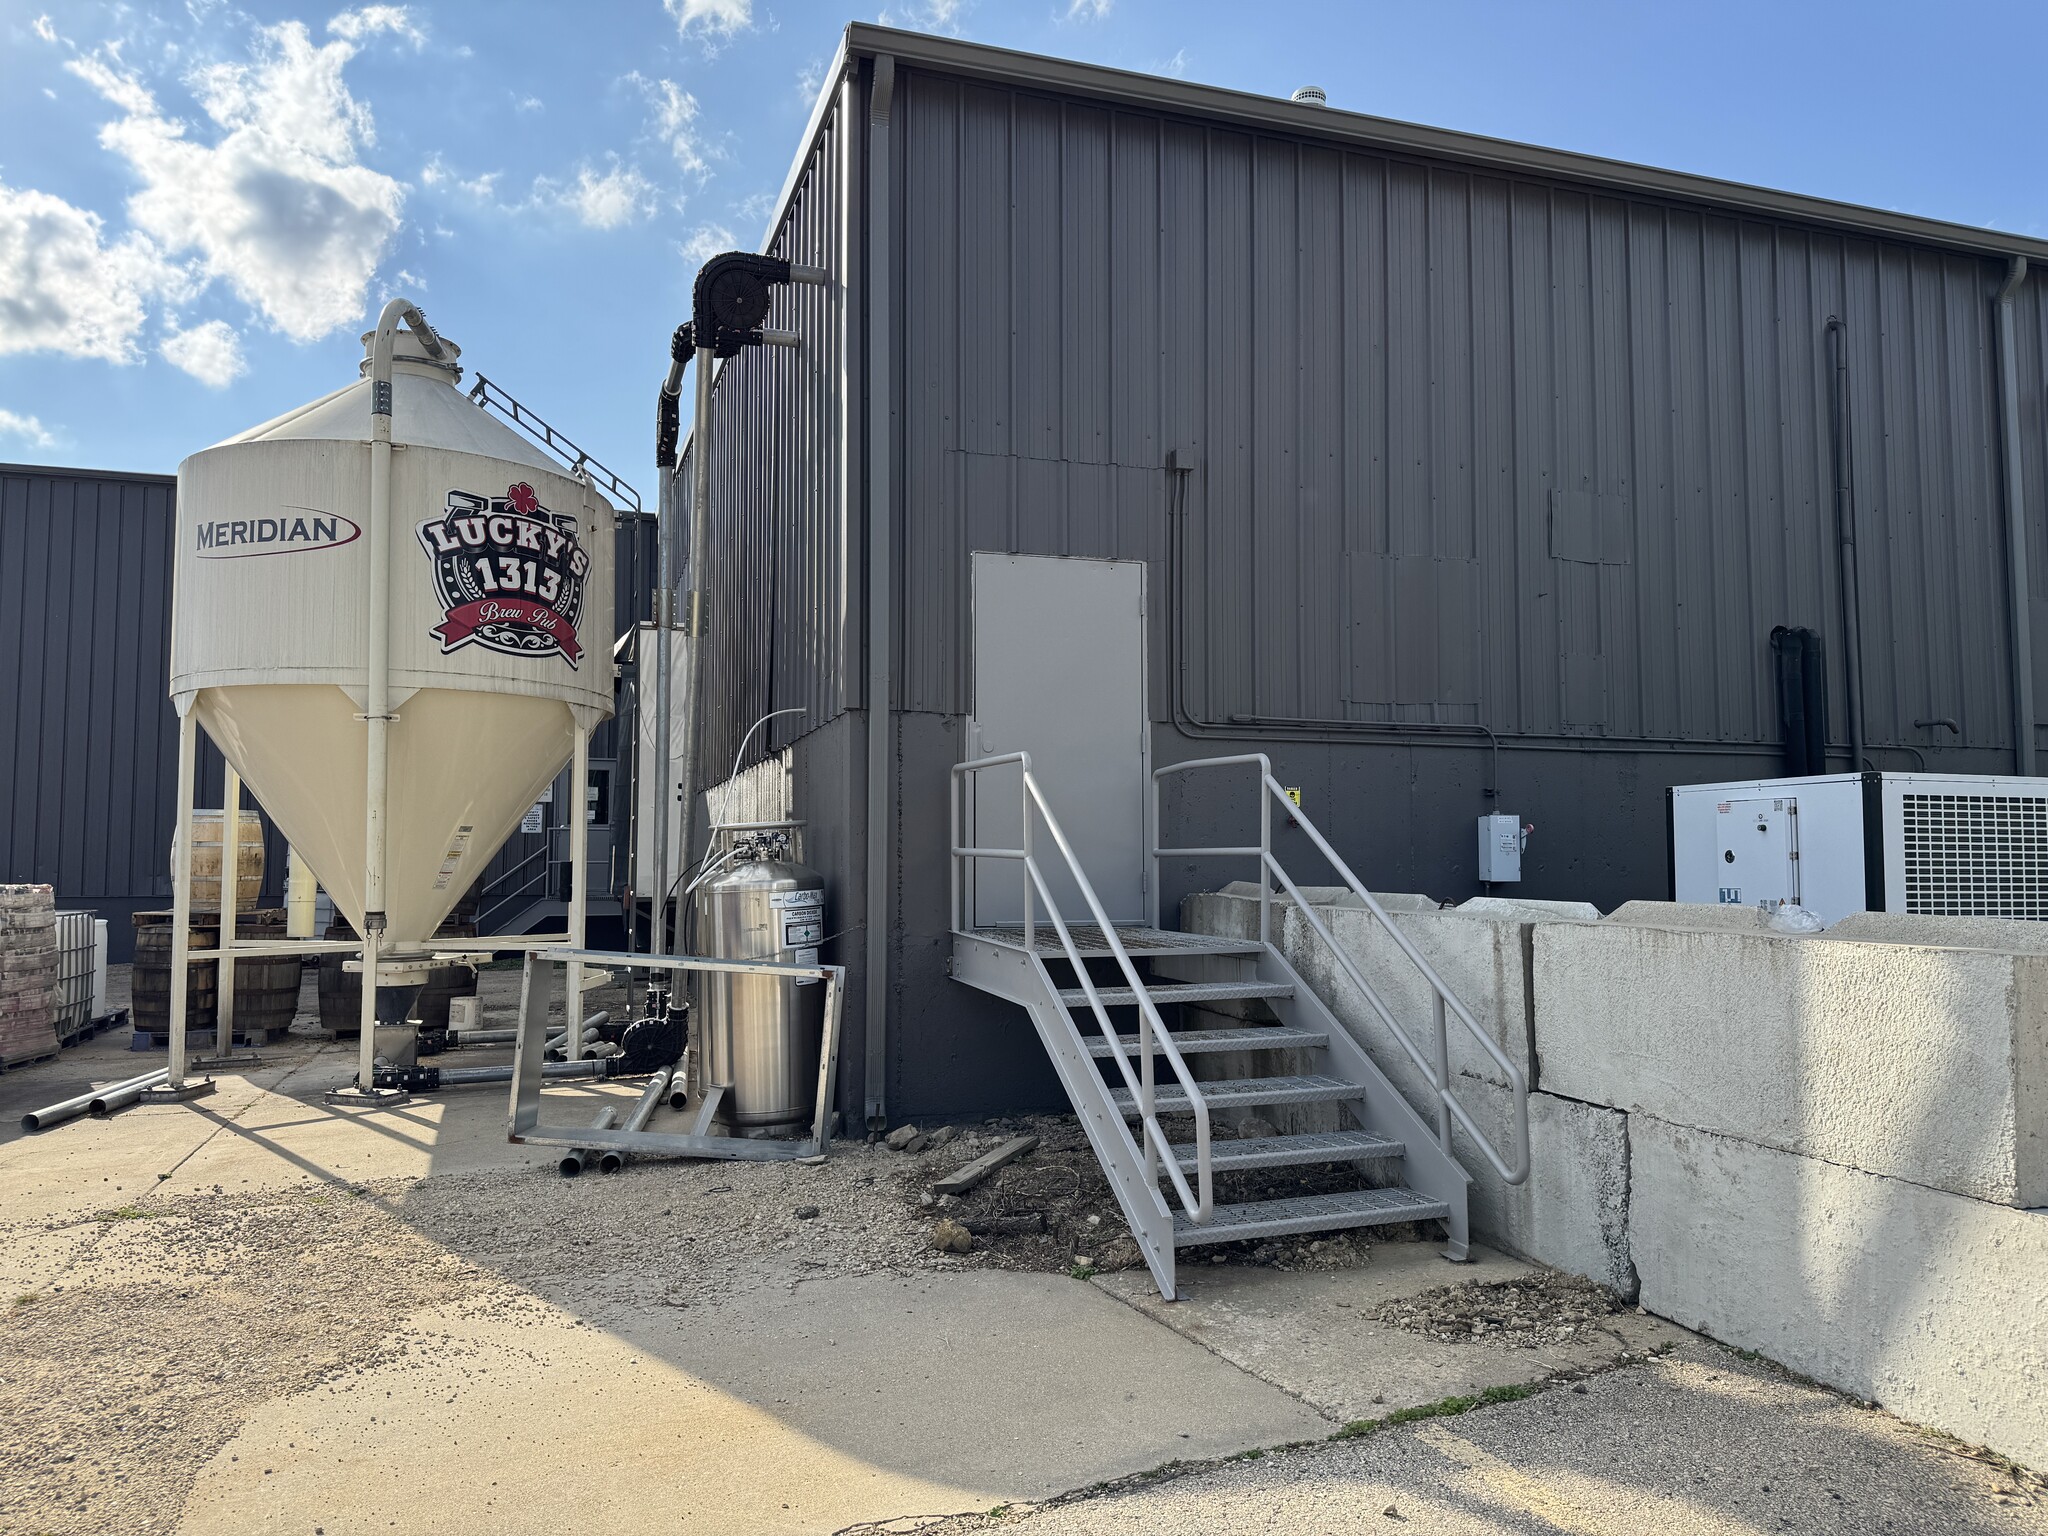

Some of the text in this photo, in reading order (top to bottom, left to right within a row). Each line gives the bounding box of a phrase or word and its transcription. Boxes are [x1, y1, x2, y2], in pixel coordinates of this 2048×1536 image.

[196, 518, 338, 551] MERIDIAN
[427, 517, 587, 577] LUCKY'S
[475, 556, 562, 603] 1313
[478, 602, 557, 630] Brew Pub
